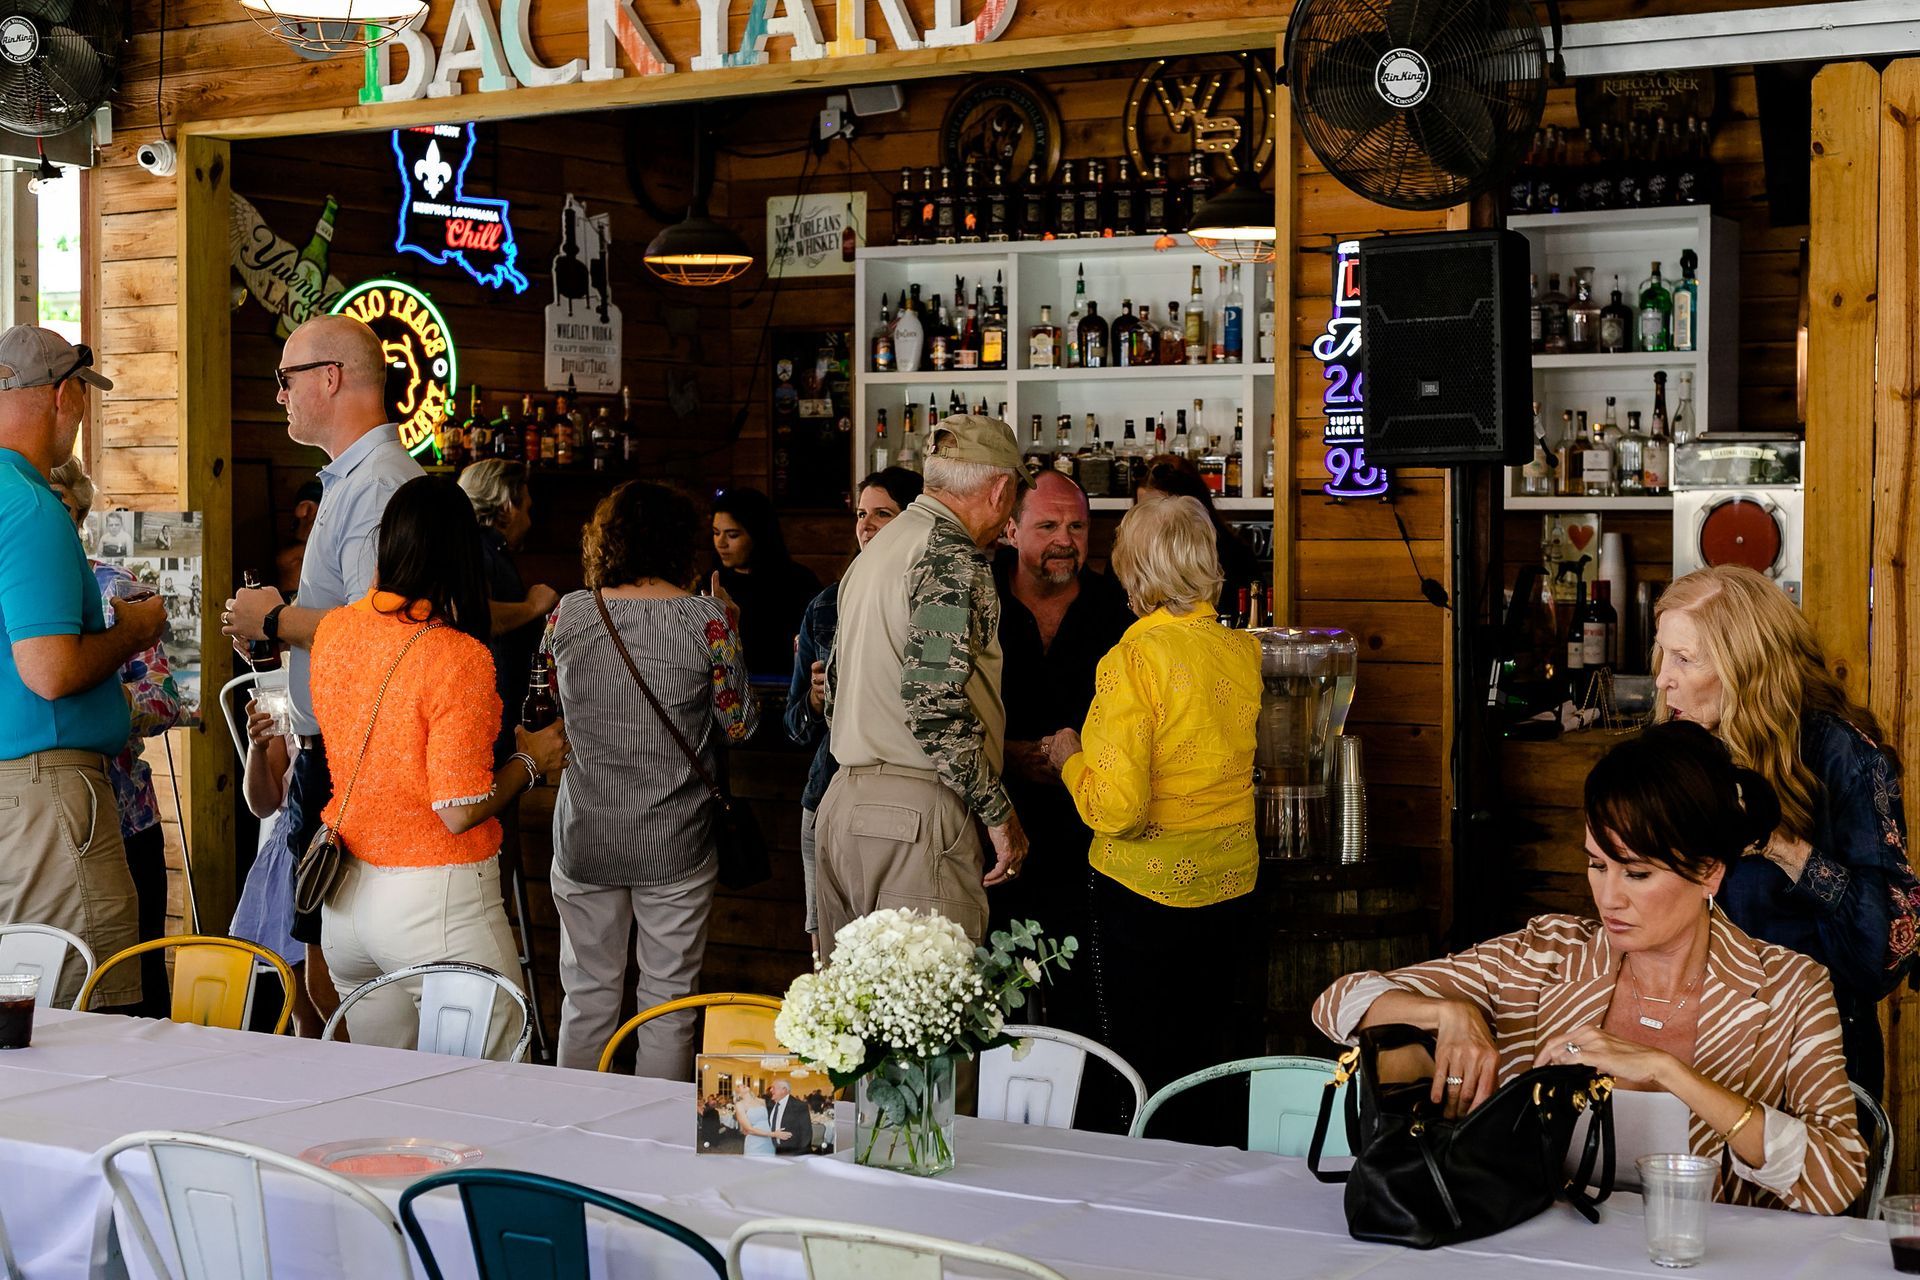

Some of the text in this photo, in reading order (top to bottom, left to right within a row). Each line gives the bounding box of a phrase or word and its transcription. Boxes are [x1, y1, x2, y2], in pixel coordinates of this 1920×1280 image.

[446, 218, 503, 252] Chill
[799, 214, 842, 240] ORLEANS
[795, 232, 841, 258] WHISKEY
[556, 323, 612, 341] WHEATLEY VODKA
[1325, 426, 1357, 436] LIGHT
[1329, 415, 1363, 426] SUPER
